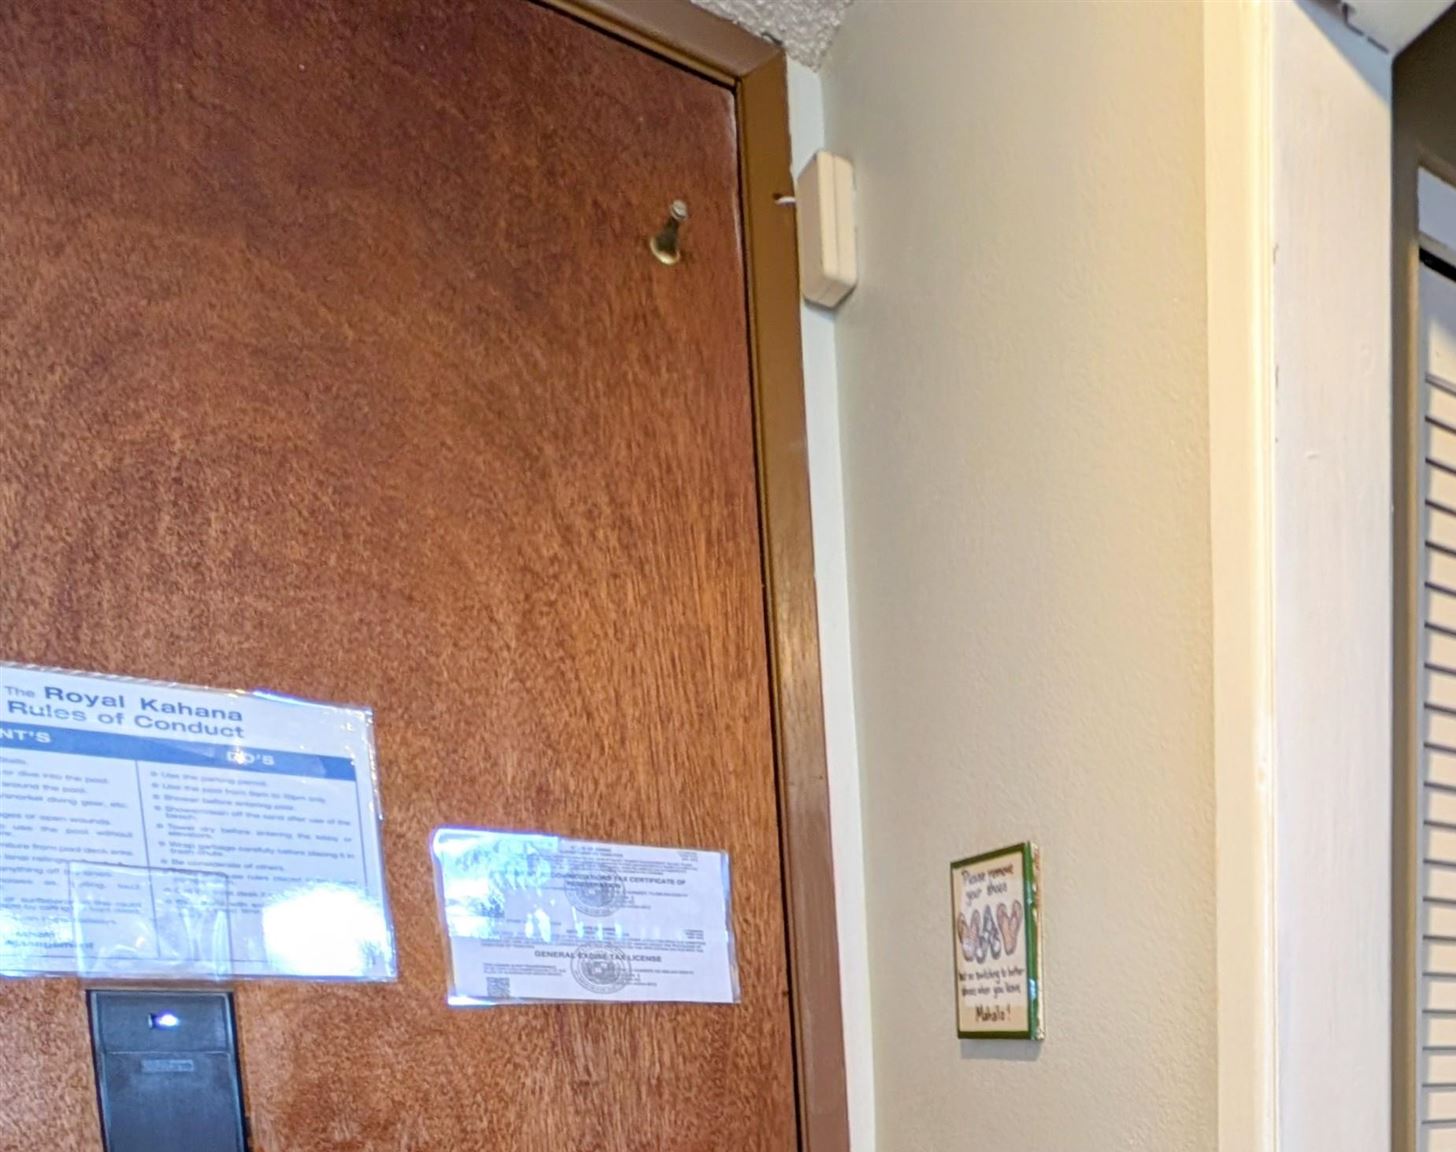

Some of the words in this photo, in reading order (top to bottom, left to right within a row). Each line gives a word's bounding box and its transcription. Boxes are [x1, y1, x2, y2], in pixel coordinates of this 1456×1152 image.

[4, 685, 36, 698] The
[44, 686, 125, 708] Royal
[140, 697, 243, 722] Kahana
[8, 700, 87, 722] Rules
[97, 712, 124, 725] of
[134, 715, 245, 739] Conduct
[534, 950, 576, 960] GENERAL
[627, 954, 662, 963] LICENSE
